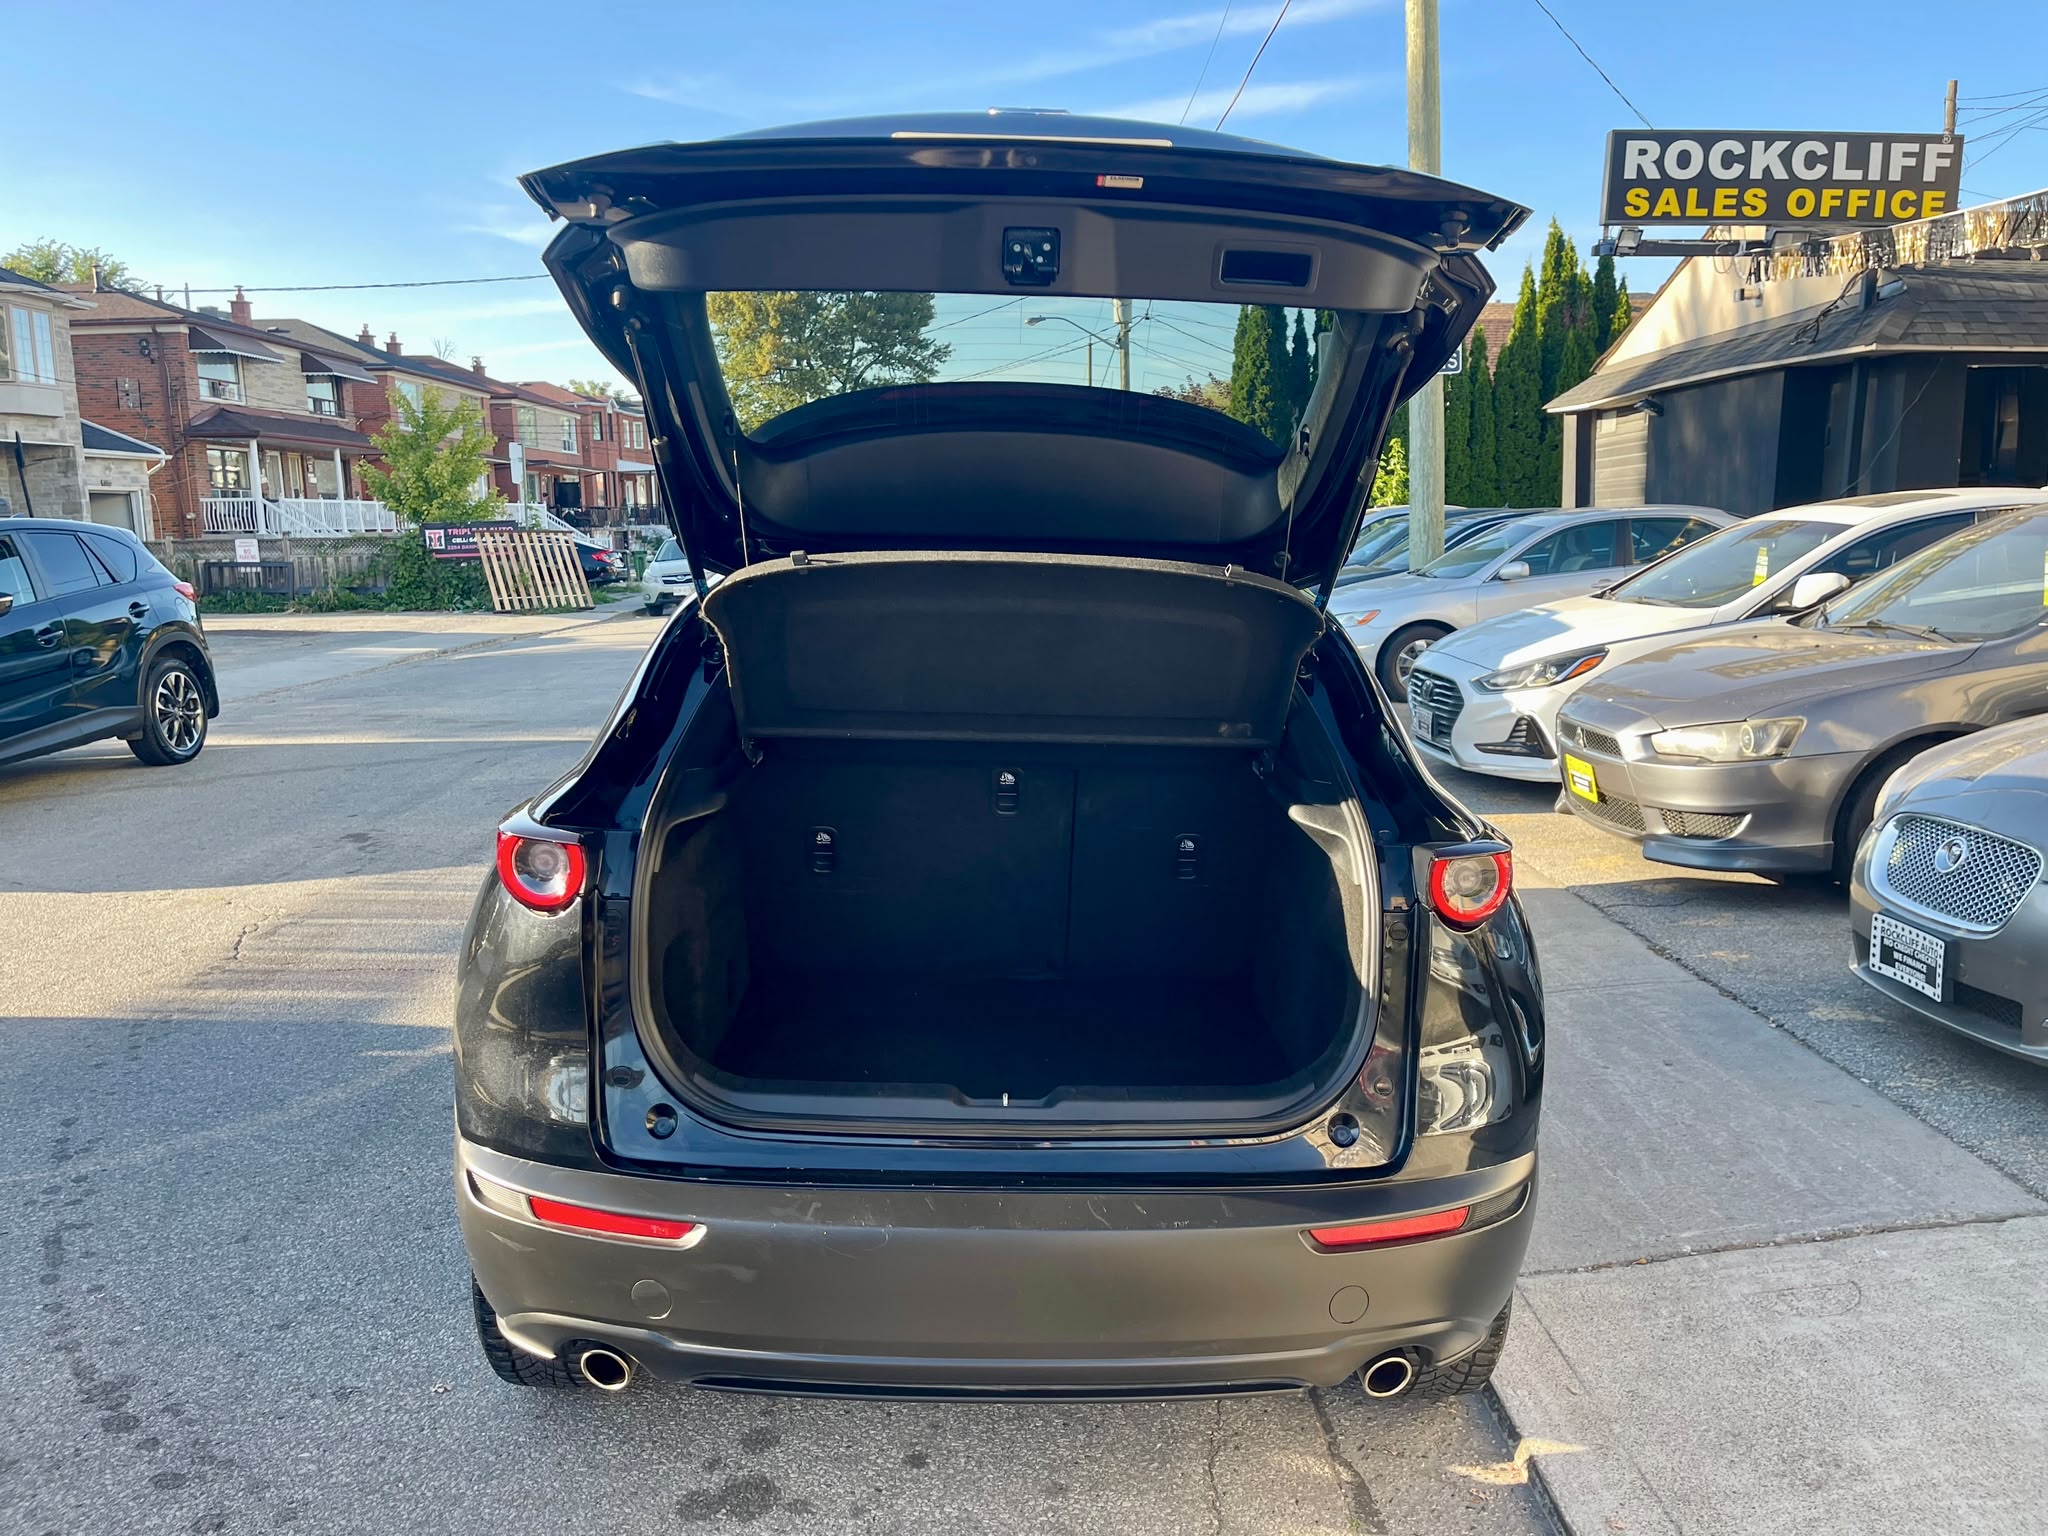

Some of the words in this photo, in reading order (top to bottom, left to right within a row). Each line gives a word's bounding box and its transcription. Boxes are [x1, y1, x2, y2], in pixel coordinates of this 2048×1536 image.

[1623, 139, 1955, 183] ROCKCLIFF
[1624, 187, 1768, 218] SALES
[1786, 188, 1947, 219] OFFICE
[1881, 926, 1919, 948] ROCKCLIFF
[1920, 943, 1939, 959] AUTO
[1883, 937, 1894, 948] NO
[1893, 951, 1903, 961] WE
[1903, 954, 1928, 973] FINANCE
